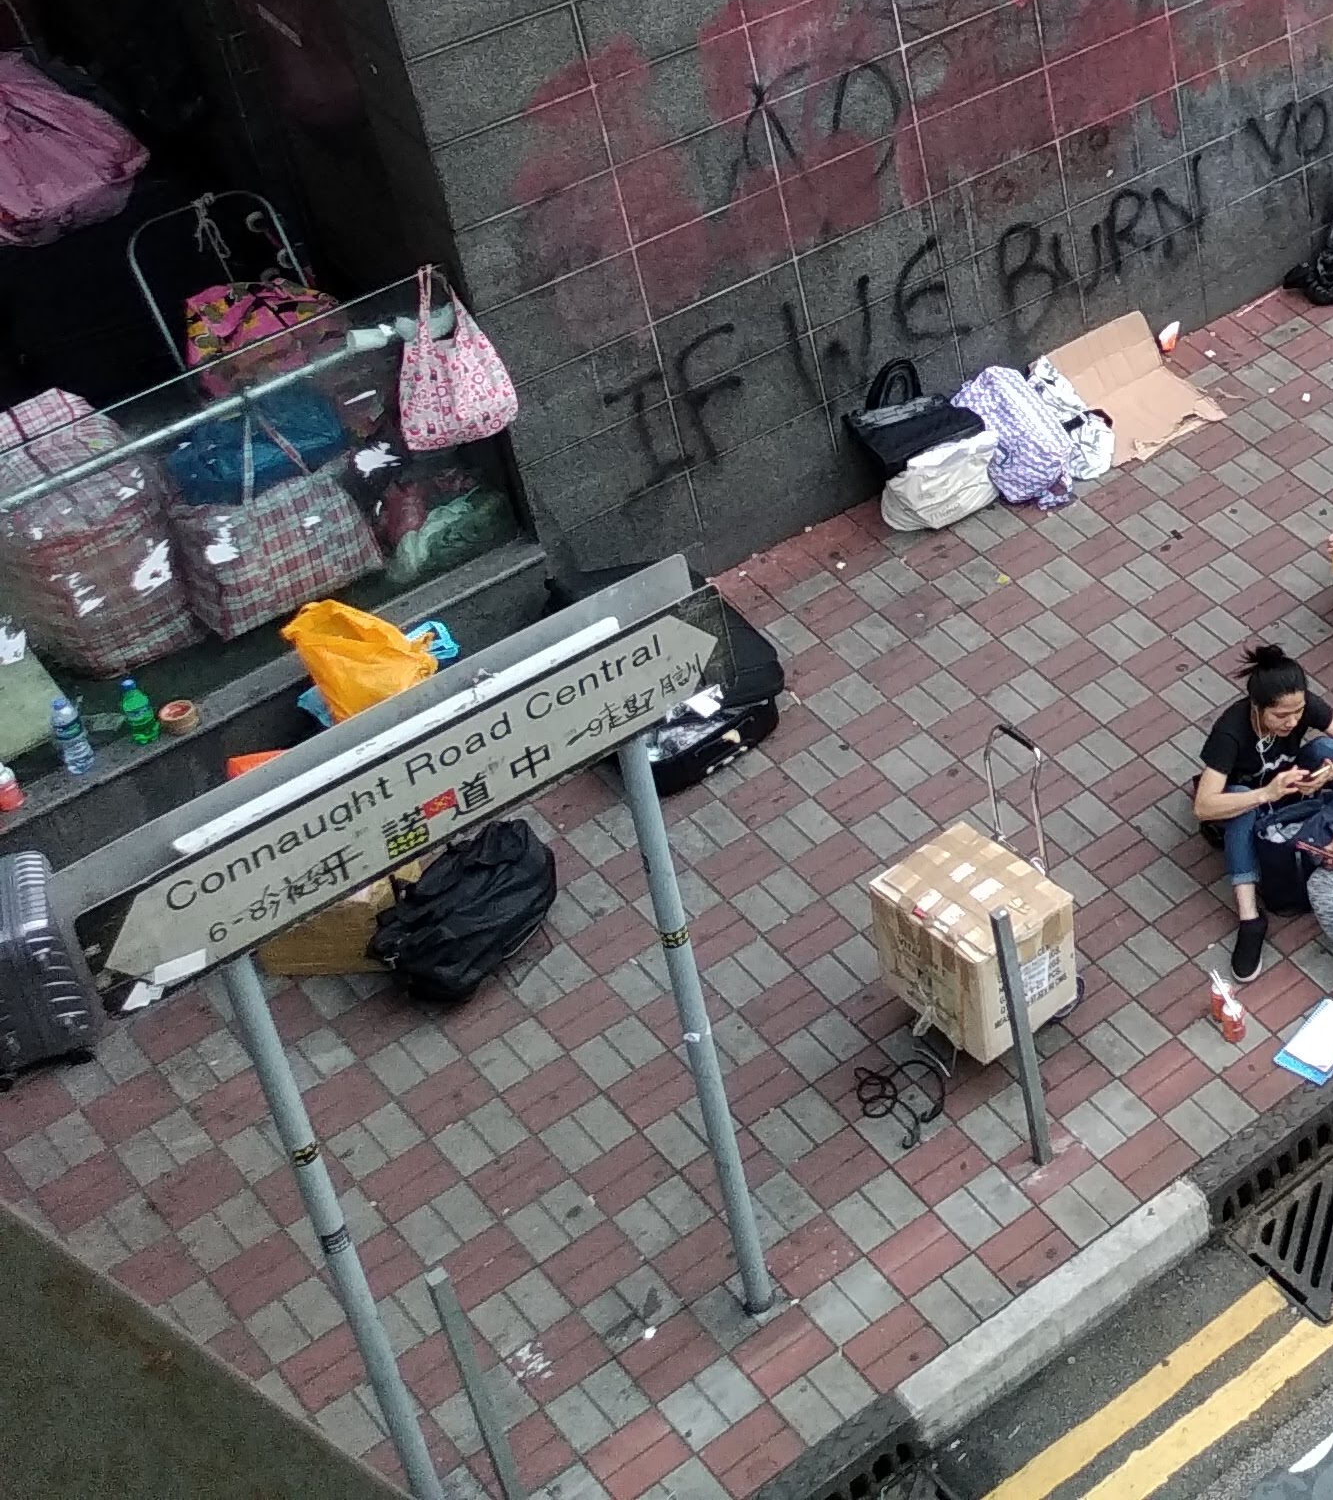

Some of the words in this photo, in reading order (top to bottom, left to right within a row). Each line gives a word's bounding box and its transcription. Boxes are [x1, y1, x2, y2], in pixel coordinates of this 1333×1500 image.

[602, 322, 743, 490] IF
[784, 236, 974, 398] WE
[1000, 153, 1206, 336] BURN
[166, 775, 394, 912] Connaught
[404, 711, 513, 786] Road
[525, 633, 663, 720] Central
